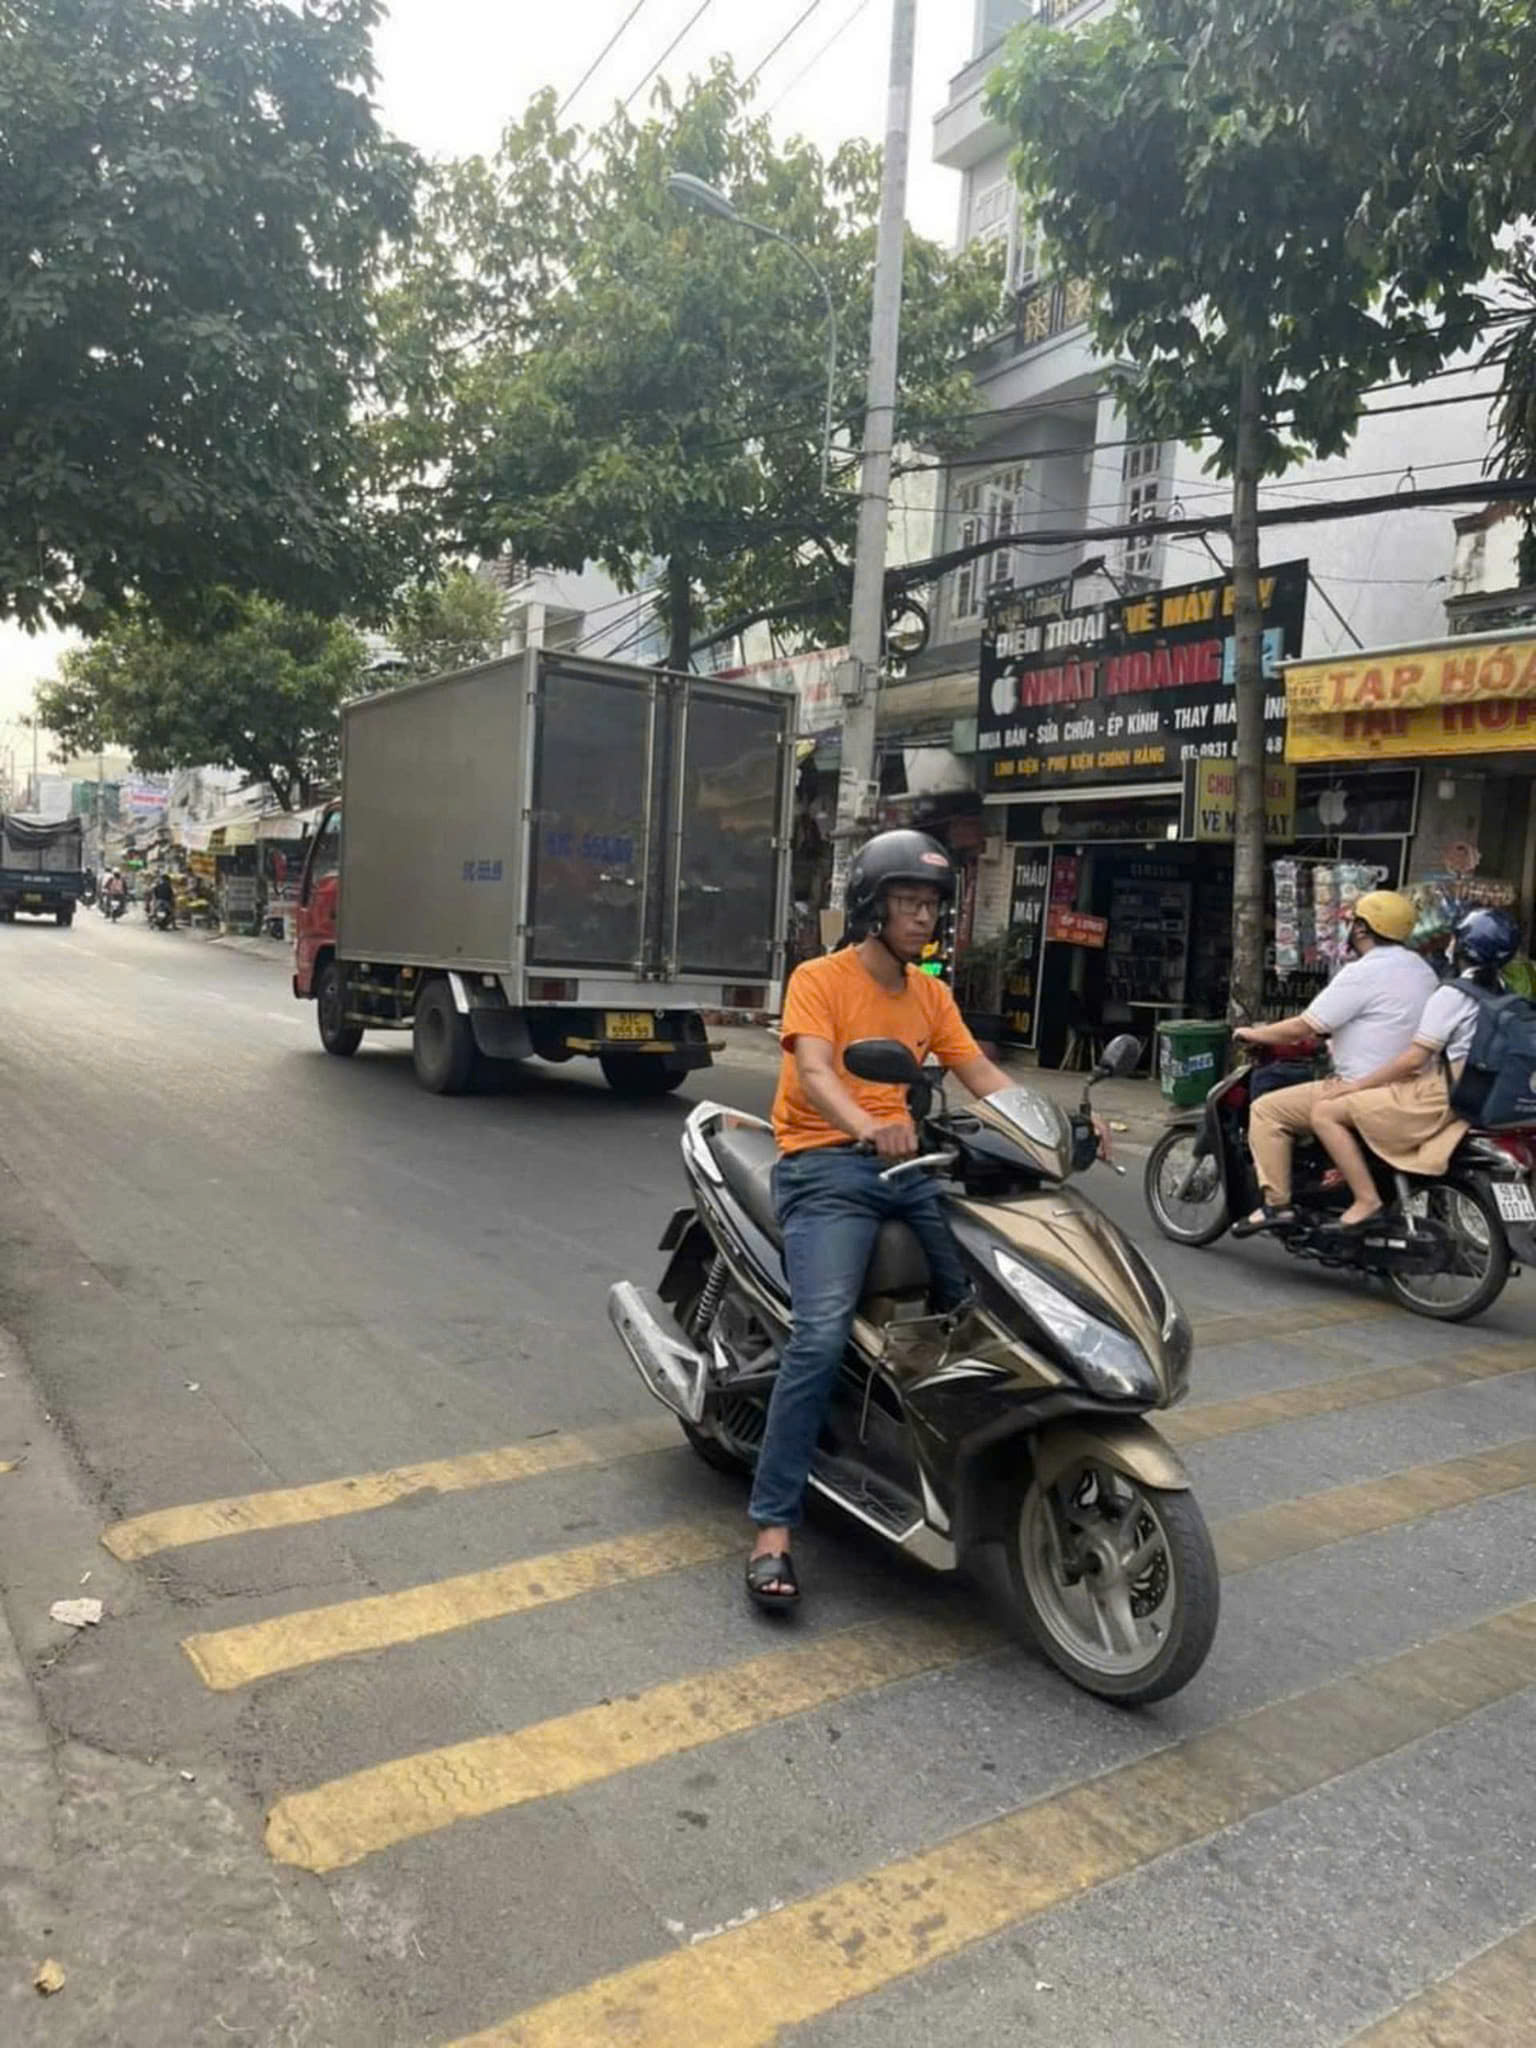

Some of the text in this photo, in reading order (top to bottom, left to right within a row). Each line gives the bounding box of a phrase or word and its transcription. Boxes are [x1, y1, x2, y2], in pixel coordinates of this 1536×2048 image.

[1044, 612, 1104, 651] THOẠI
[1125, 595, 1157, 634] VÉ
[1162, 586, 1216, 627] MÁY
[1022, 657, 1096, 709] NHẬT
[1107, 638, 1222, 696] HOÀNG
[1037, 717, 1058, 744] SỬA
[1064, 715, 1095, 741] CHỮA
[1107, 712, 1123, 737] ÉP
[1127, 709, 1158, 735] KÍNH
[1174, 705, 1208, 730] THAY
